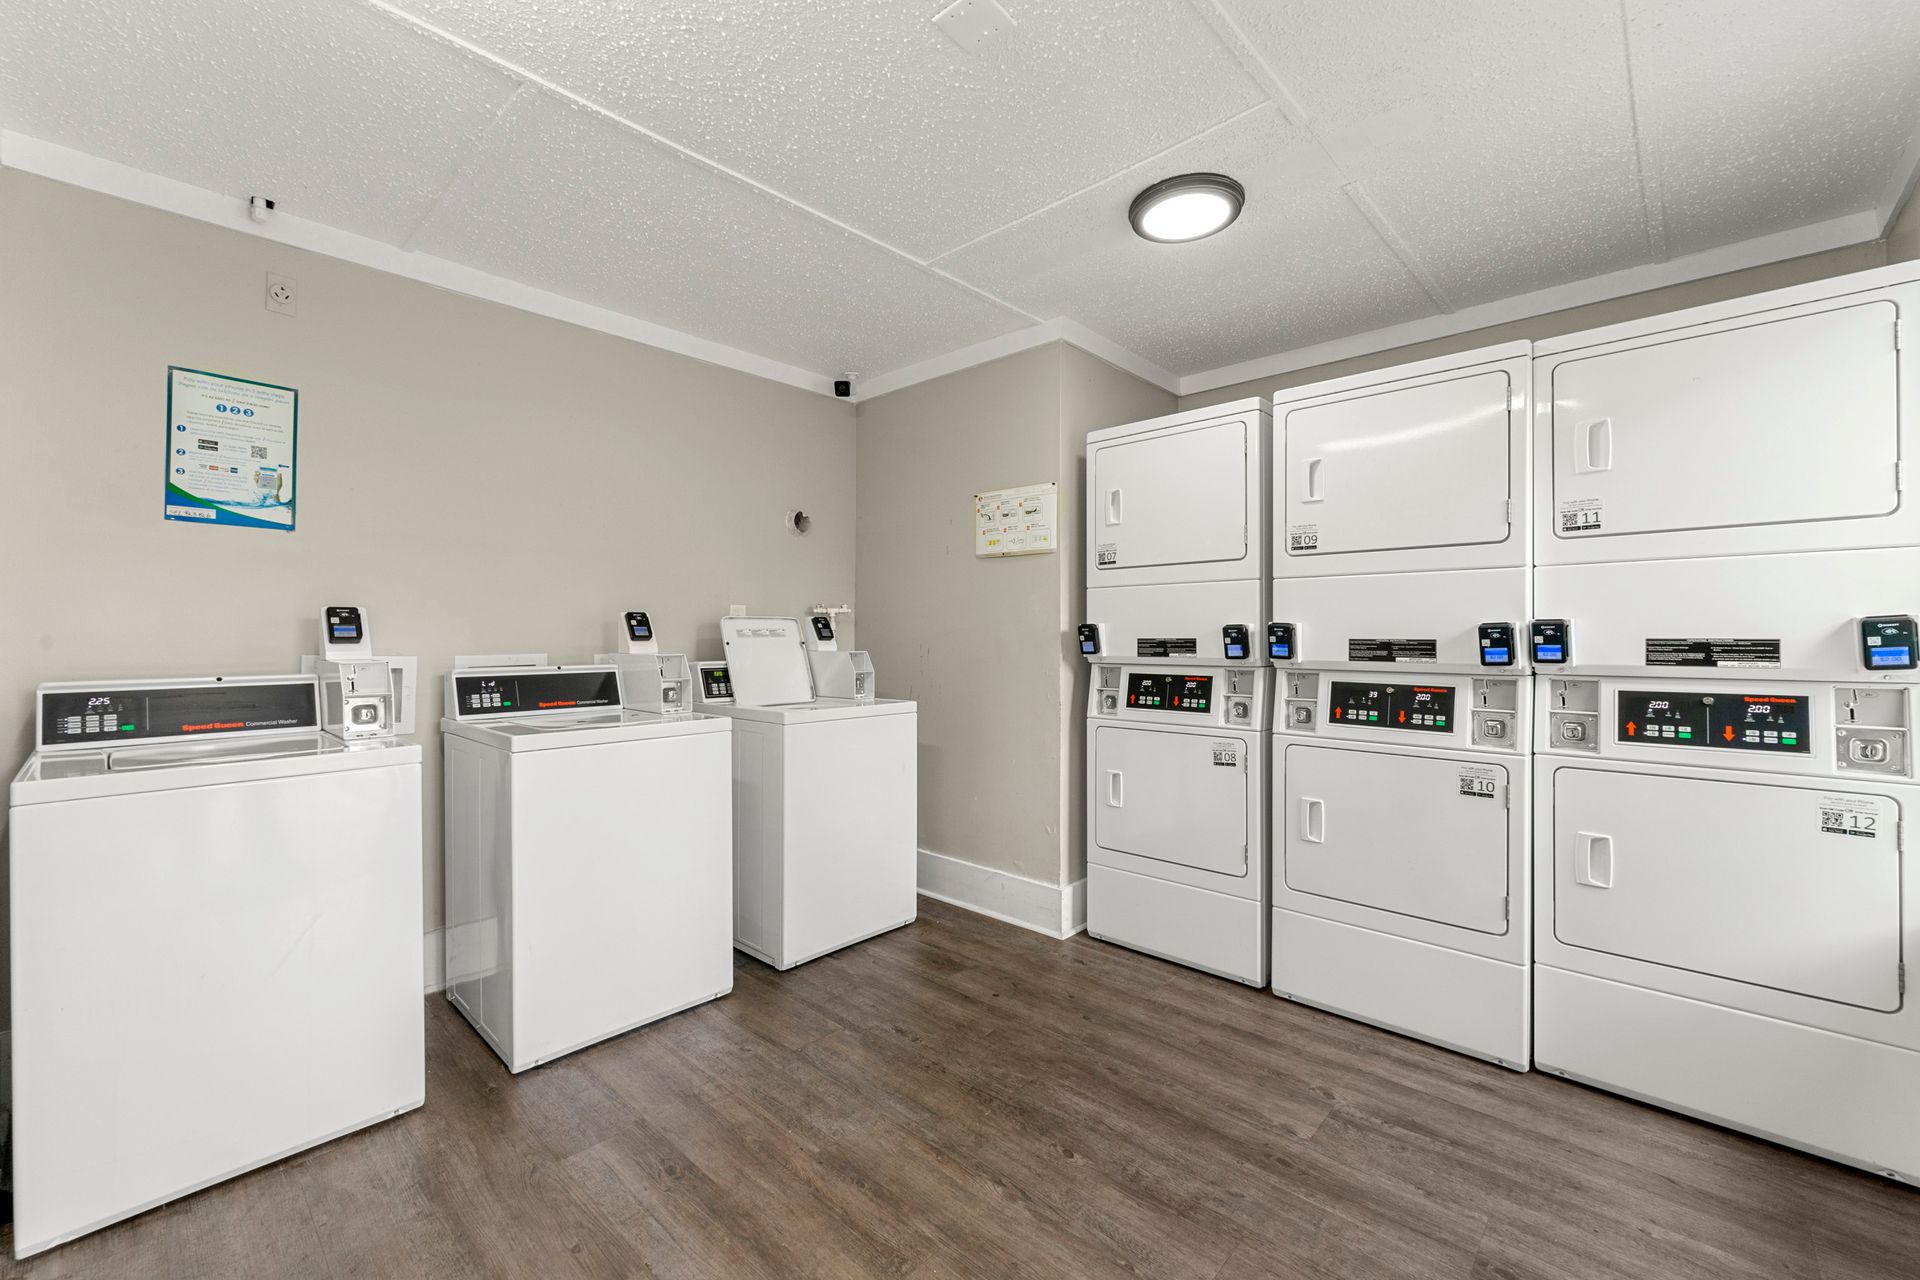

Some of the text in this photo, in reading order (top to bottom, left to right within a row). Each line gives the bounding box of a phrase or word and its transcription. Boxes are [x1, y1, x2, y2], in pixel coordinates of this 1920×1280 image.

[1582, 512, 1601, 524] 11
[1304, 535, 1318, 545] 09
[1106, 552, 1116, 561] 07
[182, 723, 213, 732] Speed
[213, 721, 245, 730] Queen
[1223, 752, 1237, 762] 08
[1477, 780, 1495, 793] 10
[1849, 815, 1876, 831] 12
